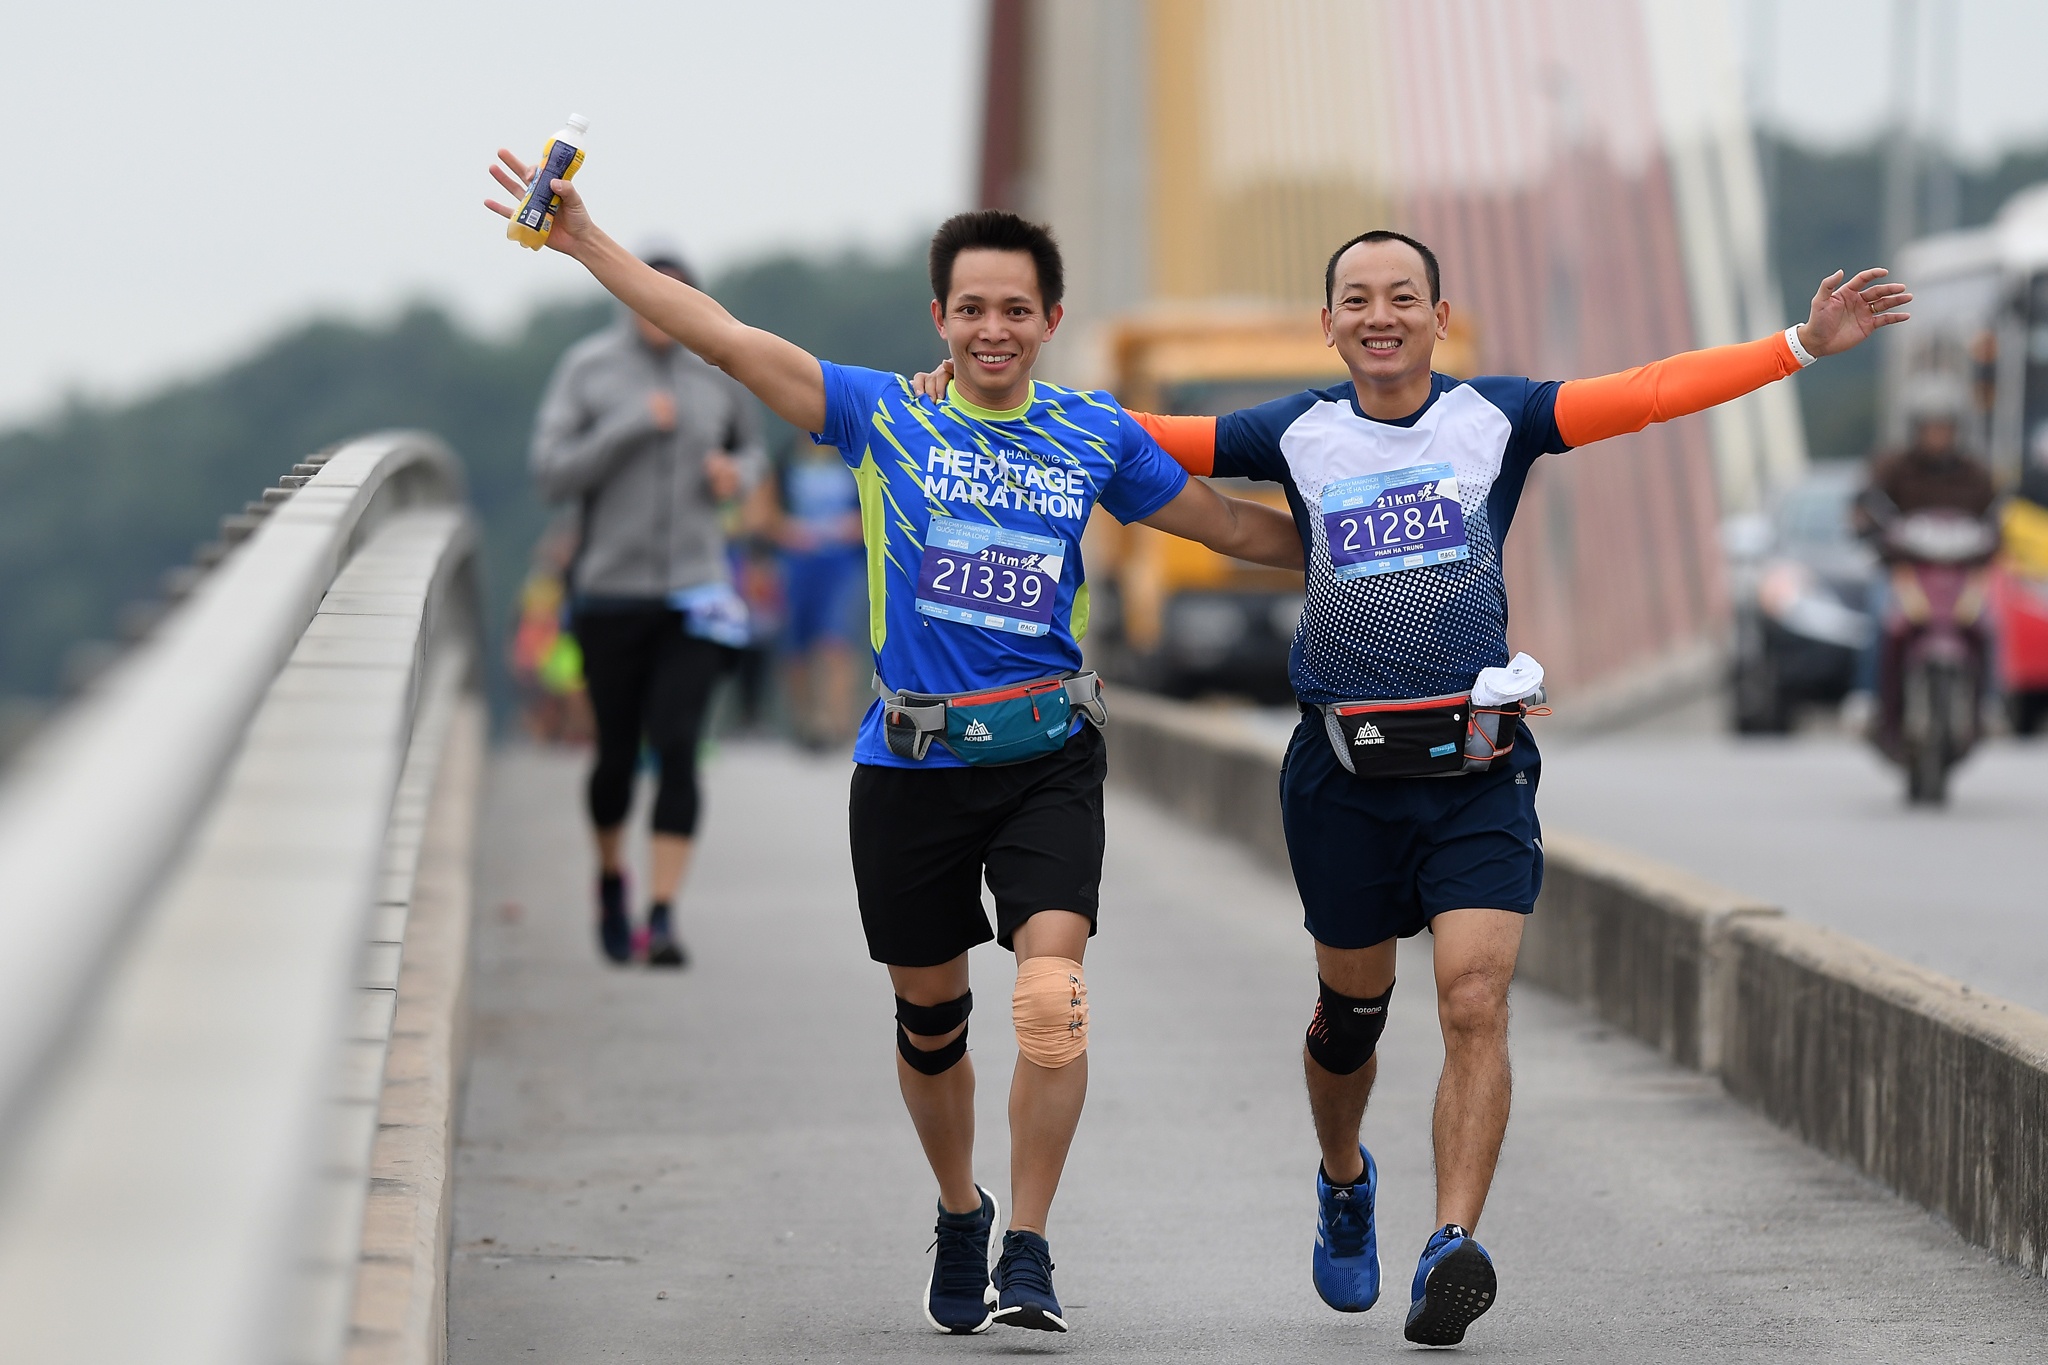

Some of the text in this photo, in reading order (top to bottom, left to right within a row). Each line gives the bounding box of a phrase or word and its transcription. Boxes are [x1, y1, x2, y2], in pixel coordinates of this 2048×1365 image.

[1006, 449, 1061, 464] HALONG
[927, 446, 1086, 495] HERITAGE
[1363, 483, 1380, 491] LONG
[924, 475, 1083, 521] MARATHON
[1376, 493, 1417, 509] 21km
[1340, 503, 1450, 551] 21284
[972, 533, 989, 541] LONG
[1375, 549, 1392, 557] PHAN
[1403, 543, 1424, 552] TRUNG
[980, 549, 1019, 567] 21km
[932, 558, 1042, 607] 21339
[1354, 738, 1385, 746] AONIJIE
[1353, 1006, 1382, 1014] aptonia
